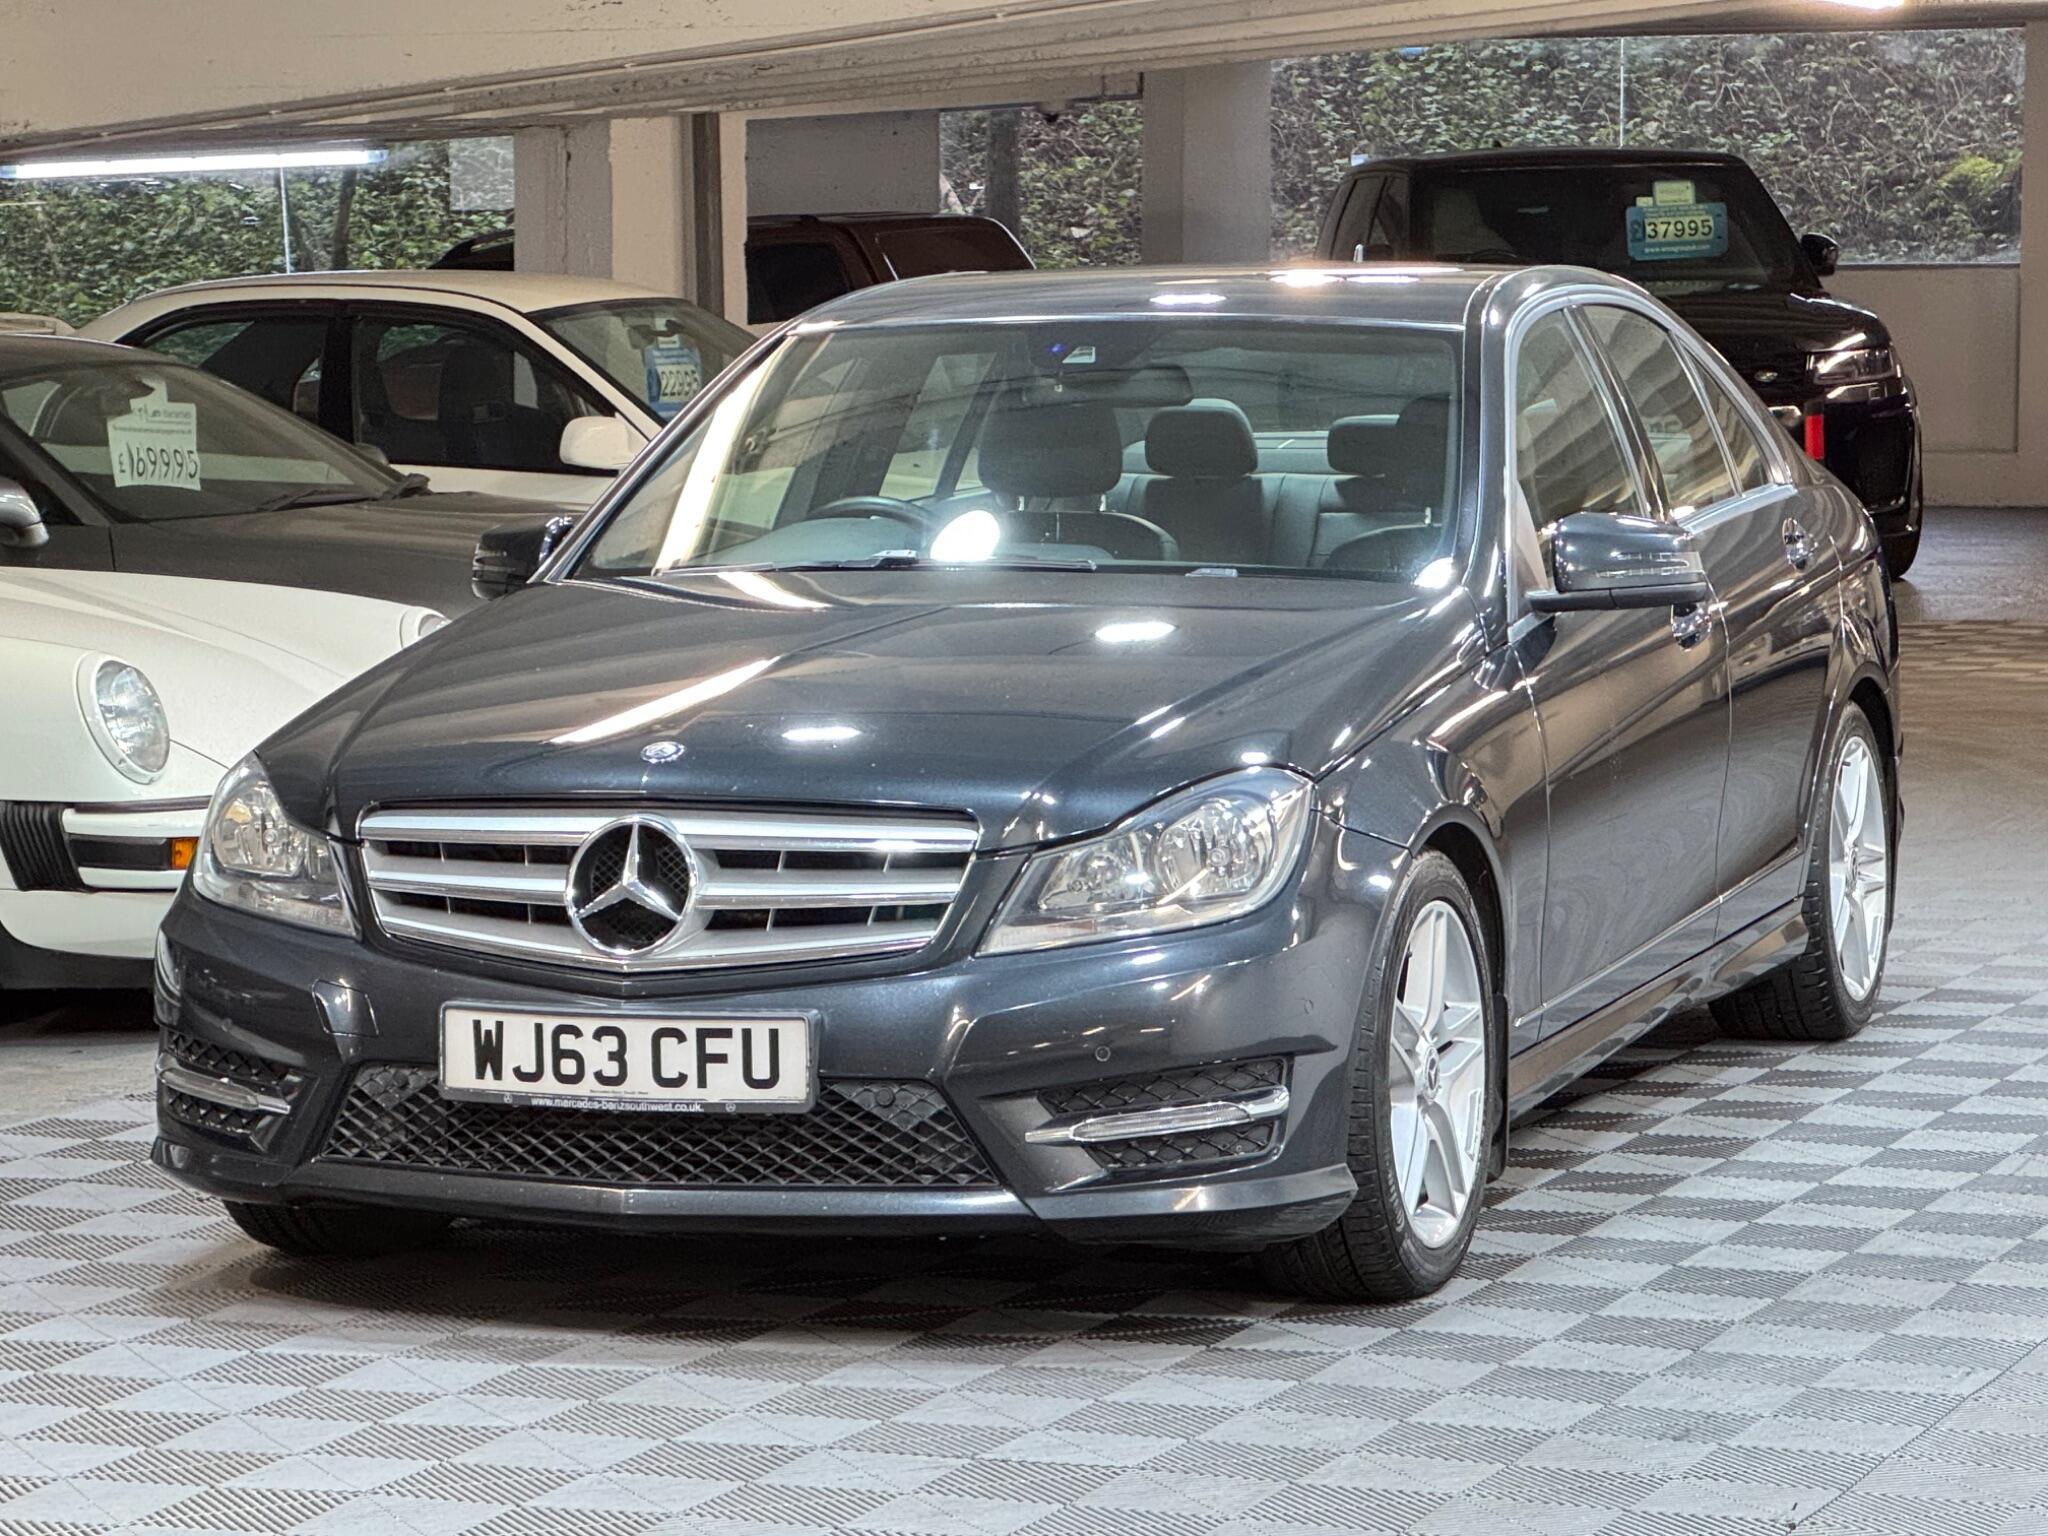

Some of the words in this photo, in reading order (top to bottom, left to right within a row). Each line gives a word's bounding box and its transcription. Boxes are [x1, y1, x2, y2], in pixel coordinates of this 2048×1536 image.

[1646, 218, 1713, 240] 37995
[471, 1018, 629, 1087] WJ63
[650, 1026, 781, 1090] CFU
